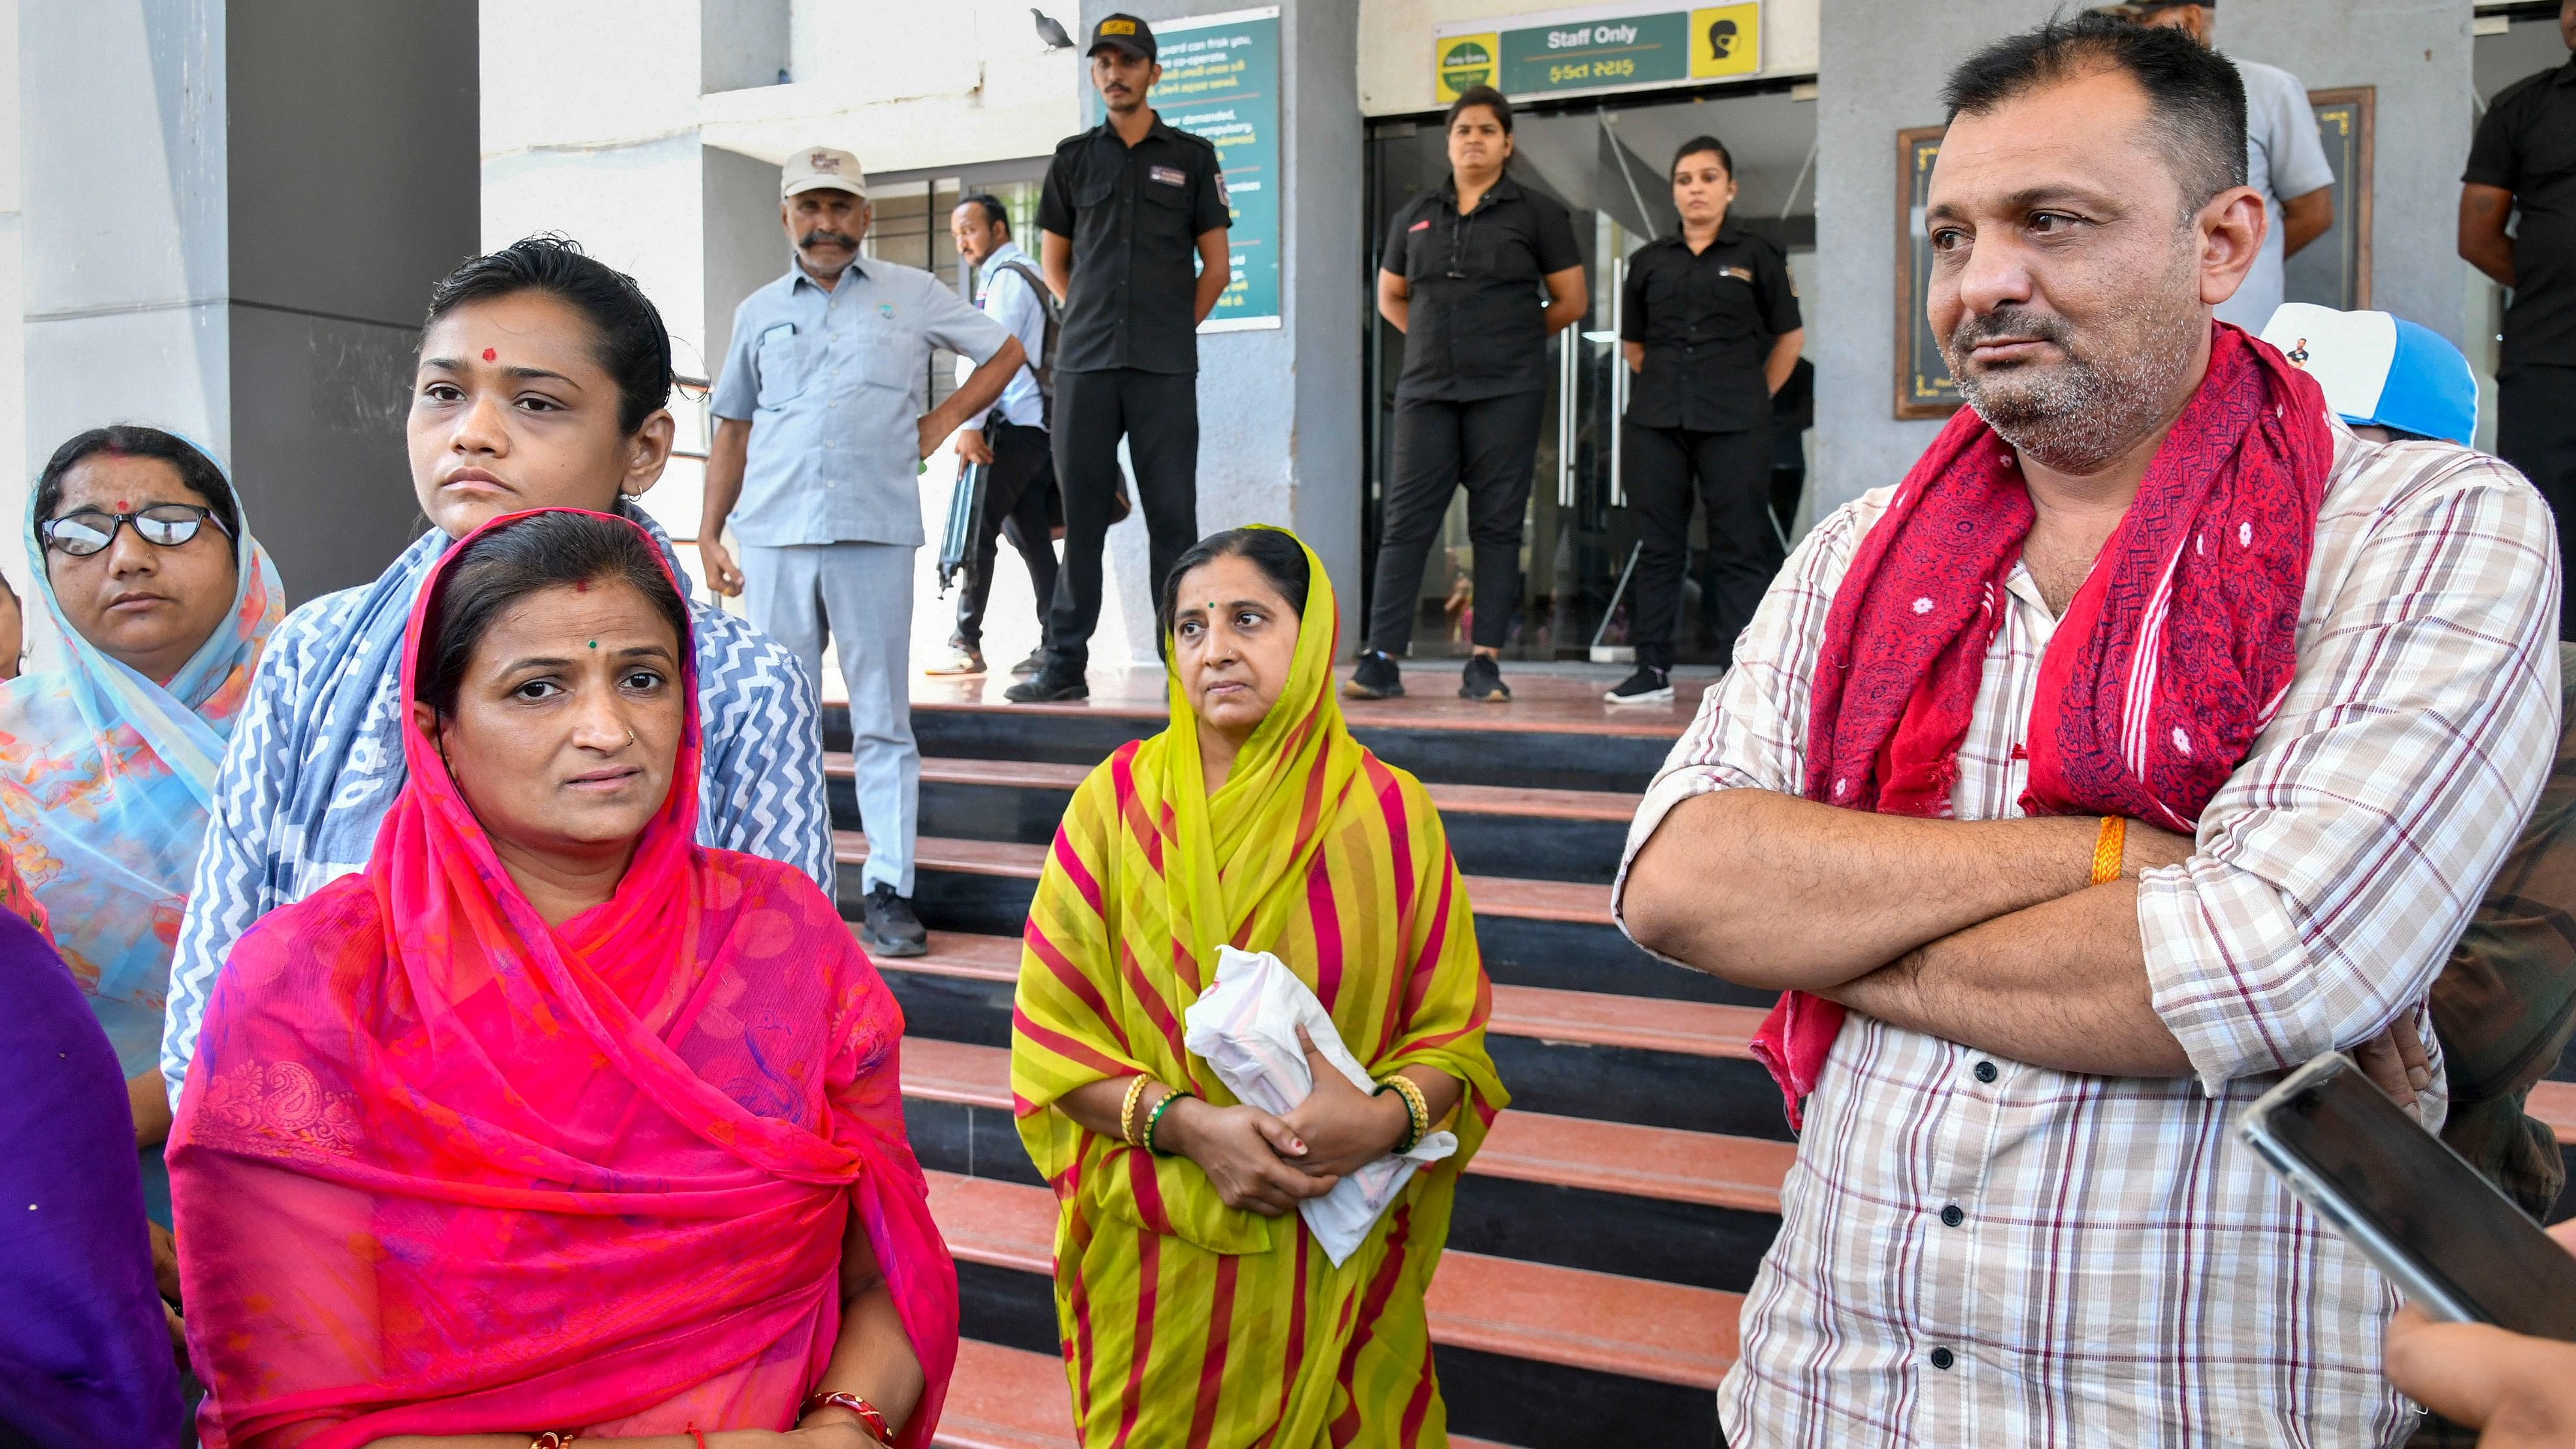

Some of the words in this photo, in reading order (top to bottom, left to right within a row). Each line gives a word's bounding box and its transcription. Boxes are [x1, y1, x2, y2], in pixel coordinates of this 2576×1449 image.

[1548, 27, 1591, 49] Staff
[1594, 24, 1637, 44] Only
[1158, 42, 1186, 57] guard
[1187, 42, 1206, 52] can
[1207, 37, 1229, 48] frisk
[1182, 109, 1237, 125] demanded,
